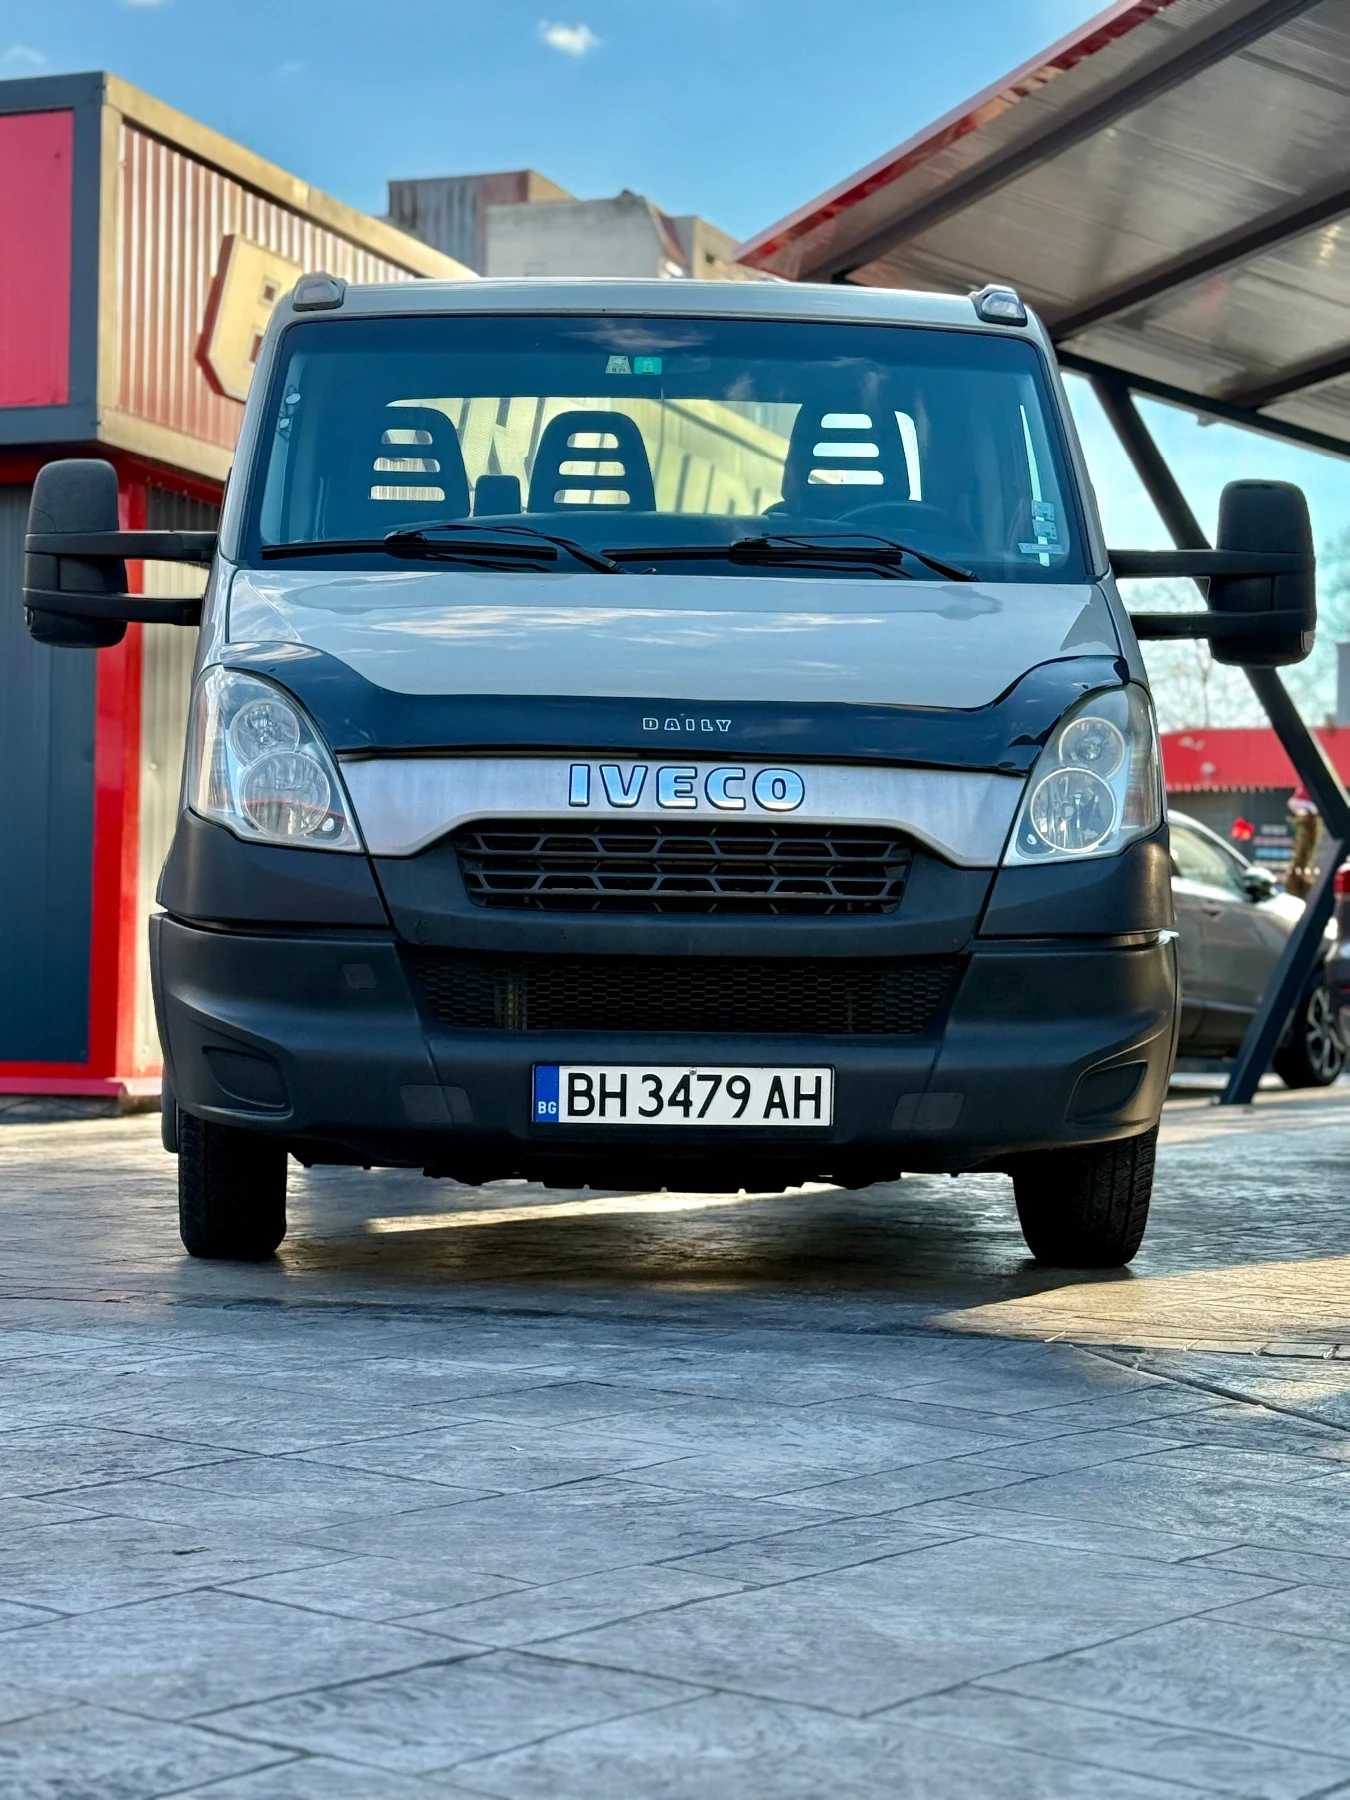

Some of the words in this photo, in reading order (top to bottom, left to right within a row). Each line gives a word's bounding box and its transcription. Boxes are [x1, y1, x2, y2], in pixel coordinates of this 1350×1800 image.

[642, 717, 732, 732] DAILY
[568, 763, 806, 812] IVECO
[537, 1101, 557, 1115] BG
[567, 1072, 627, 1117] BH
[638, 1074, 751, 1118] 3479
[763, 1075, 822, 1119] AH
